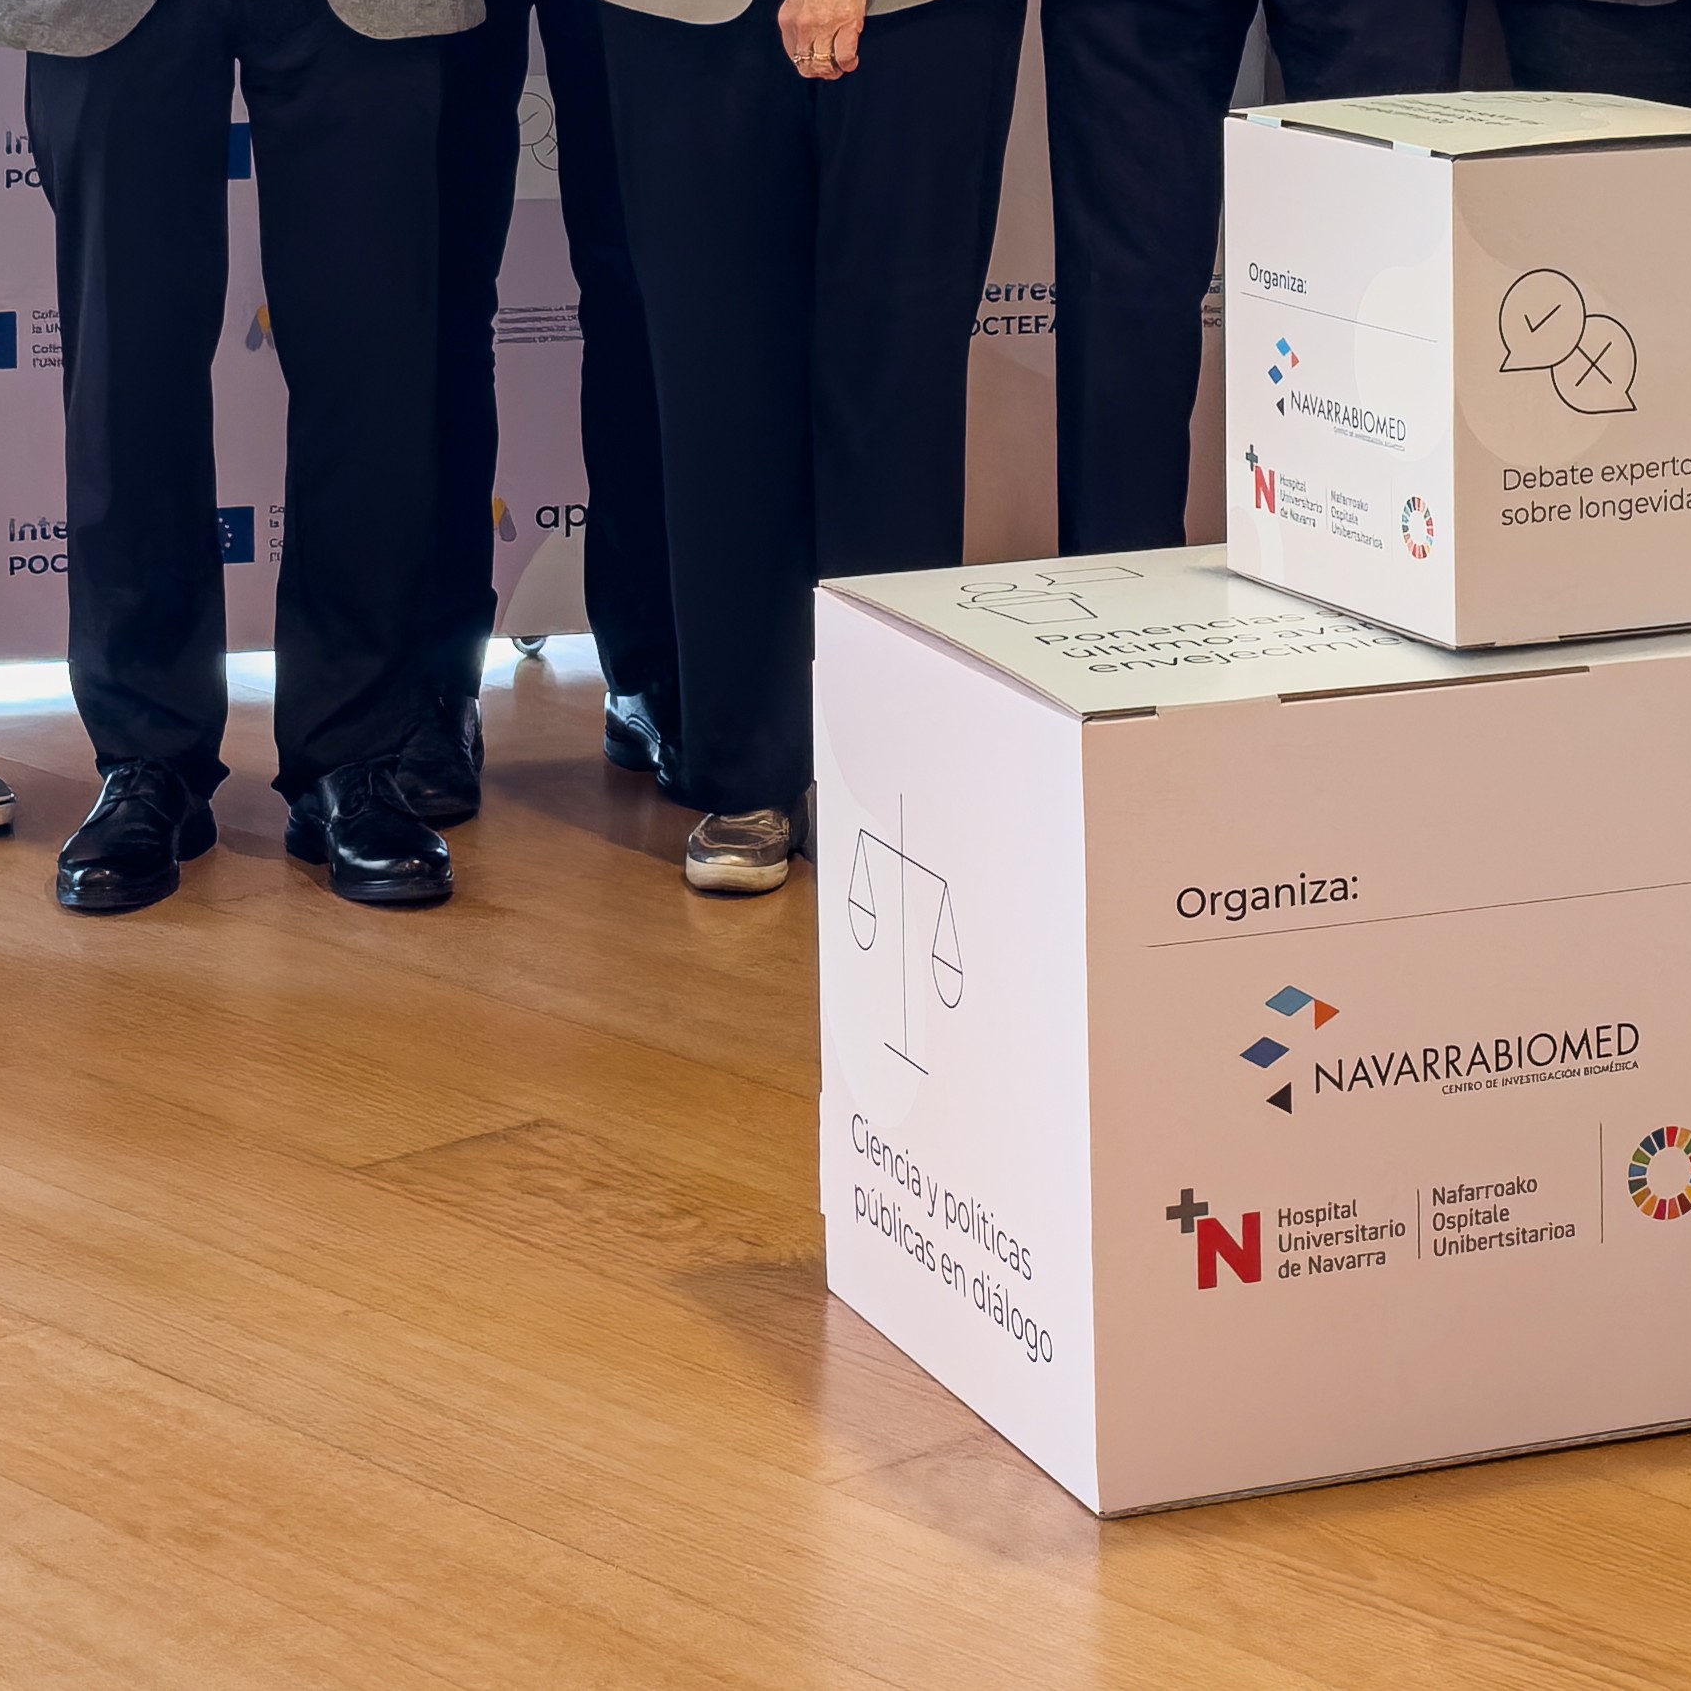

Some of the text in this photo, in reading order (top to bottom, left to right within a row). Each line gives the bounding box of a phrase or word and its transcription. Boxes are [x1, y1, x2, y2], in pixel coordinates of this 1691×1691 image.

[1249, 262, 1307, 294] Organiza:
[1291, 390, 1406, 441] NAVARRABIOMED
[1279, 473, 1306, 493] Hospital
[1503, 465, 1594, 491] Debate
[1280, 490, 1322, 514] Universitario
[1501, 500, 1572, 526] sobre
[9, 517, 68, 542] Inte
[1290, 511, 1316, 528] Navarra
[1034, 612, 1305, 646] Ponencias
[1062, 633, 1262, 660] últimos
[1087, 635, 1403, 674] envejecimie
[1176, 872, 1358, 921] Organiza:
[1314, 1022, 1640, 1094] NAVARRABIOMED
[1441, 1078, 1484, 1095] CENTRO
[1485, 1078, 1499, 1089] DE
[1583, 1060, 1639, 1077] BIOMÉDICA
[851, 1113, 1032, 1281] Ciencia y políticas
[1432, 1176, 1538, 1207] Nafarroako
[1277, 1199, 1358, 1228] Hospital
[1432, 1205, 1511, 1232] Ospitale
[1197, 1211, 1262, 1290] N
[1278, 1219, 1406, 1253] Universitario
[1432, 1222, 1577, 1257] Unibertsitarioa
[854, 1184, 1053, 1363] públicas en diálogo
[1277, 1250, 1387, 1279] de Navarra
